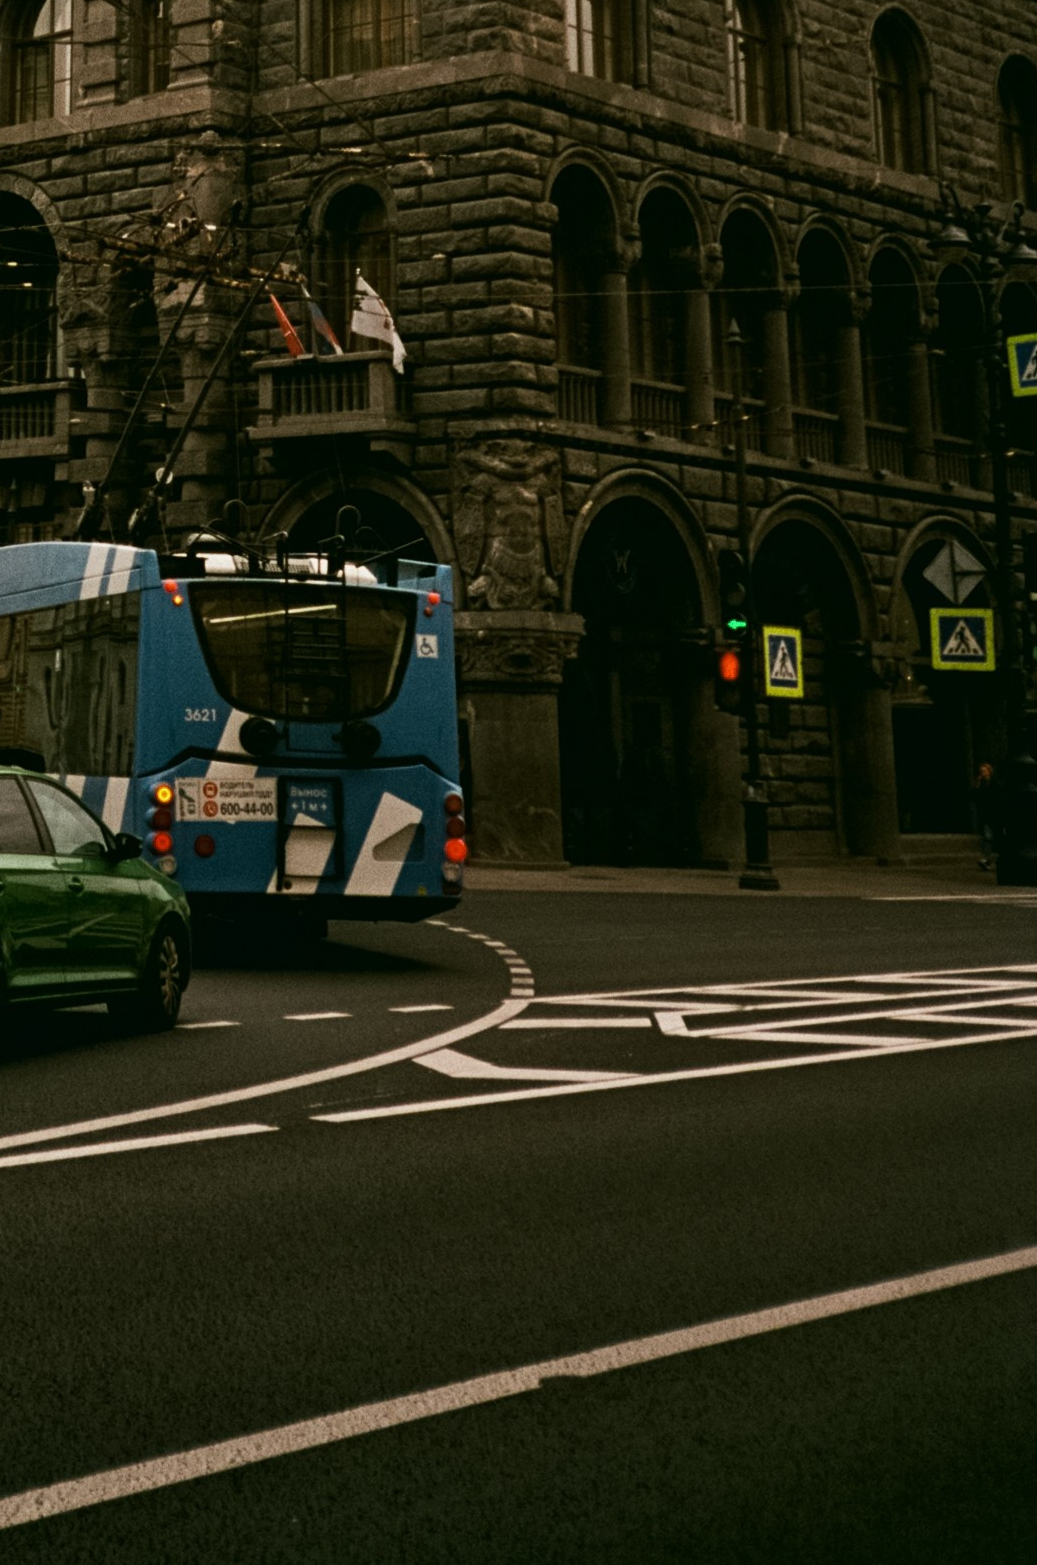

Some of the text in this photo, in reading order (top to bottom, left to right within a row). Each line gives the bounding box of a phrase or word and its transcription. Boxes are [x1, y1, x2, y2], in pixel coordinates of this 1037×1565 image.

[184, 708, 217, 722] 3621
[290, 786, 327, 798] Вынос
[220, 802, 274, 815] 600-44-00
